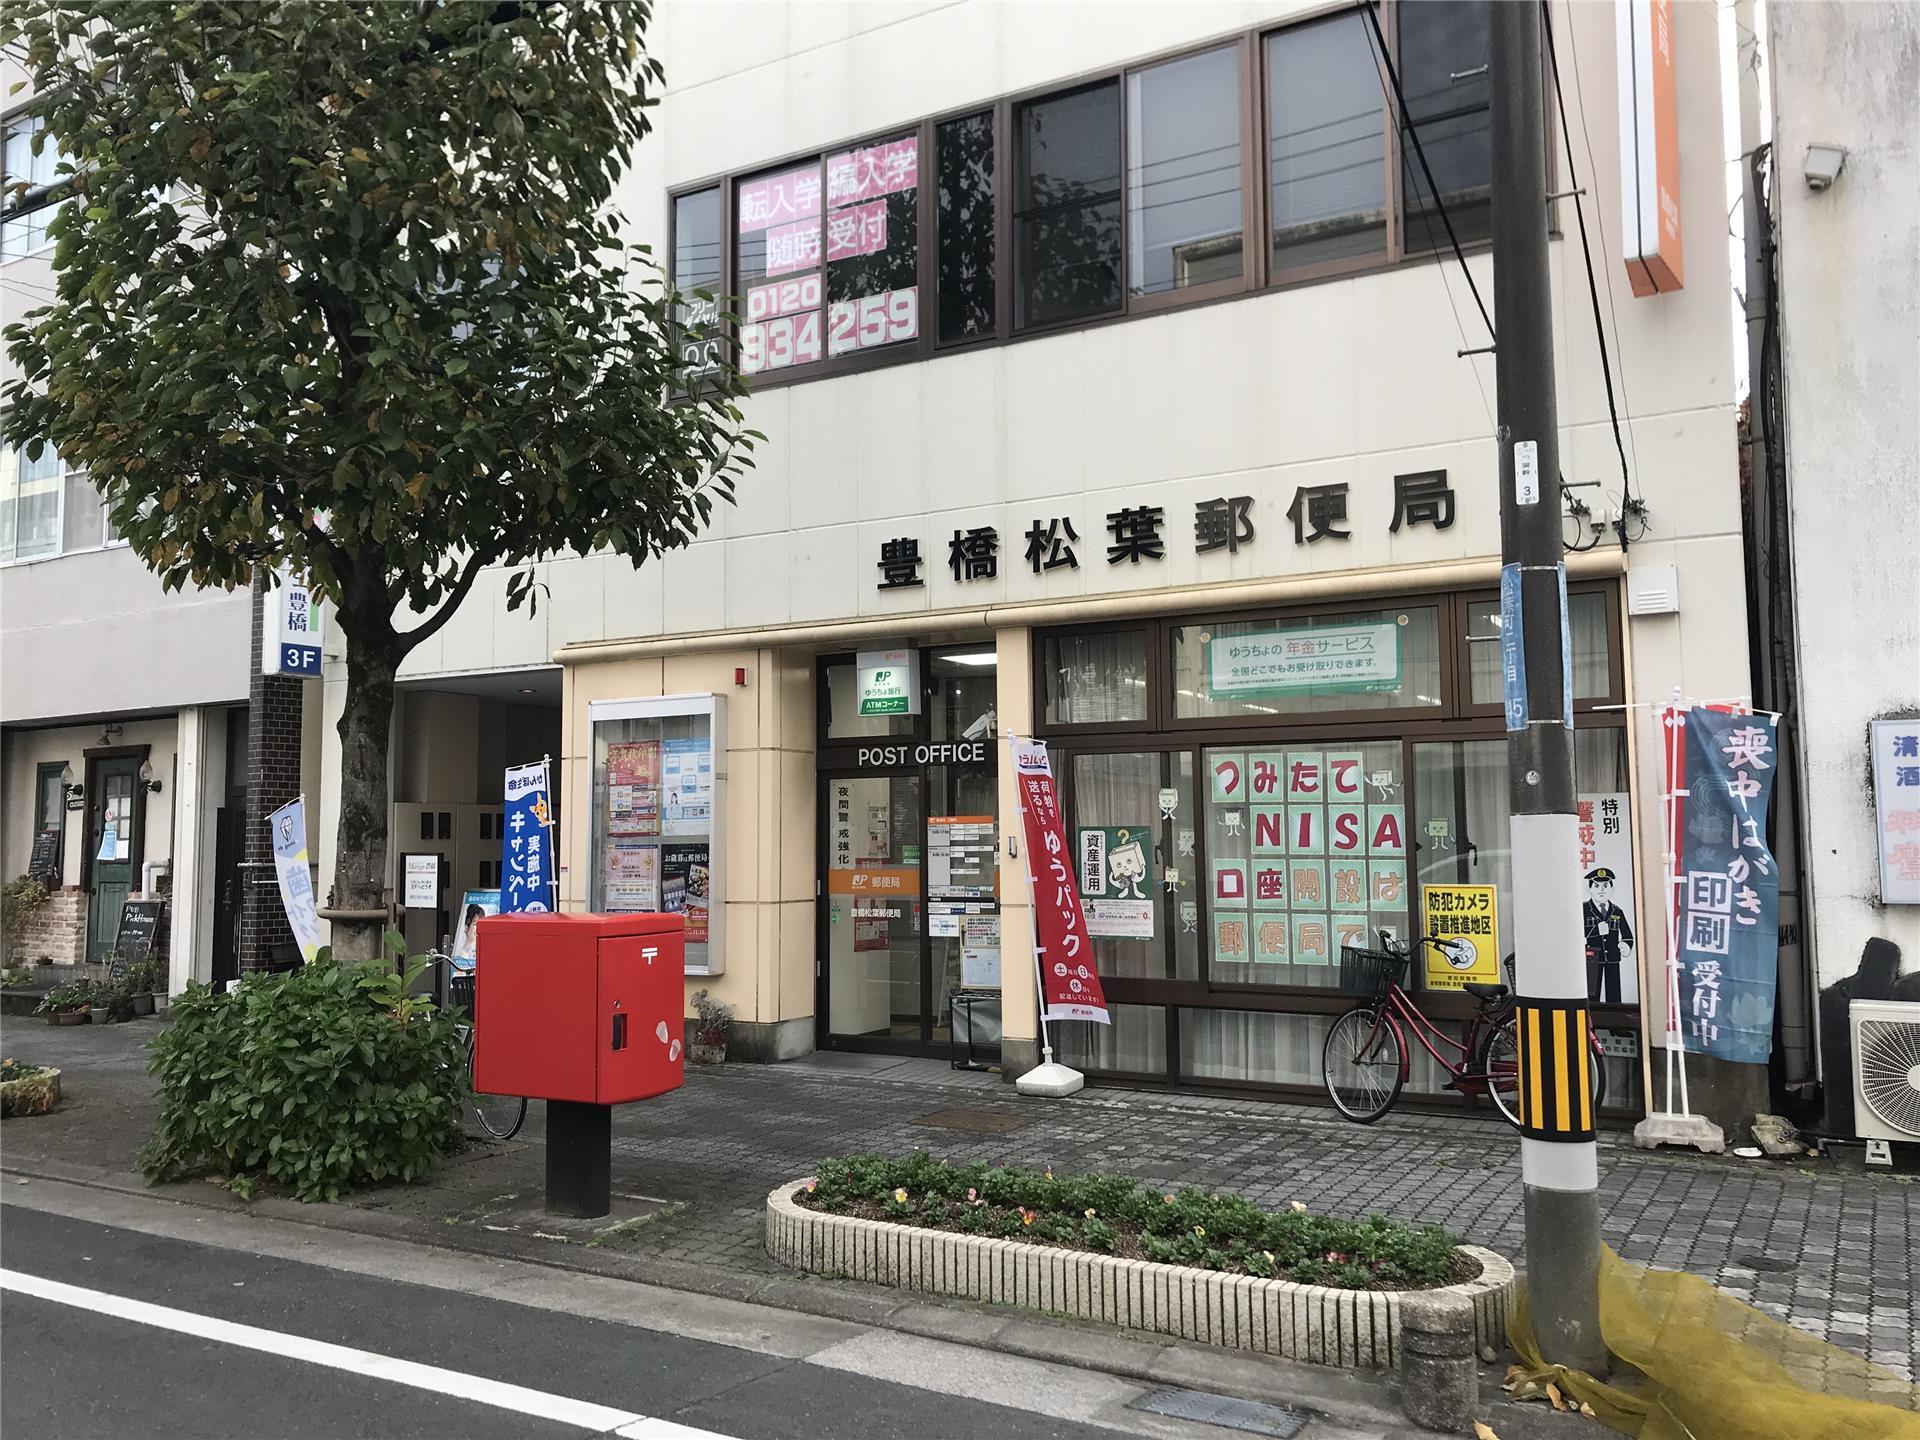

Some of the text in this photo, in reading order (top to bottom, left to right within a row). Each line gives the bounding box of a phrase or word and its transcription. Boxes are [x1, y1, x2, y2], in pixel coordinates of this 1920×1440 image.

[741, 178, 821, 224] 転入学
[749, 279, 820, 318] 0120
[1523, 485, 1532, 496] 3
[876, 468, 1456, 592] 豊橋松葉郵便局
[287, 648, 316, 669] 3F
[1229, 635, 1375, 659] ゆうちょの 年金サービス
[864, 686, 901, 698] ゆうちょ銀行
[866, 700, 905, 710] ATMコーナー
[858, 743, 985, 766] POST OFFICE
[1215, 759, 1359, 795] つみたて
[838, 786, 849, 865] 夜間警戒強化
[1255, 813, 1402, 850] NISA
[1601, 798, 1620, 835] 特別
[1721, 725, 1773, 926] 喪中はがき
[1577, 800, 1595, 870] 警戒中
[1087, 834, 1100, 891] 資産運用
[871, 876, 900, 889] 郵便局
[1043, 829, 1081, 957] ゆうパック
[1216, 868, 1404, 904] 口座開設は
[1428, 892, 1490, 912] 防犯カメラ
[1218, 921, 1365, 956] 郵便局で
[1429, 914, 1492, 935] 設置推進地区
[1688, 873, 1729, 1047] 印刷 受付中
